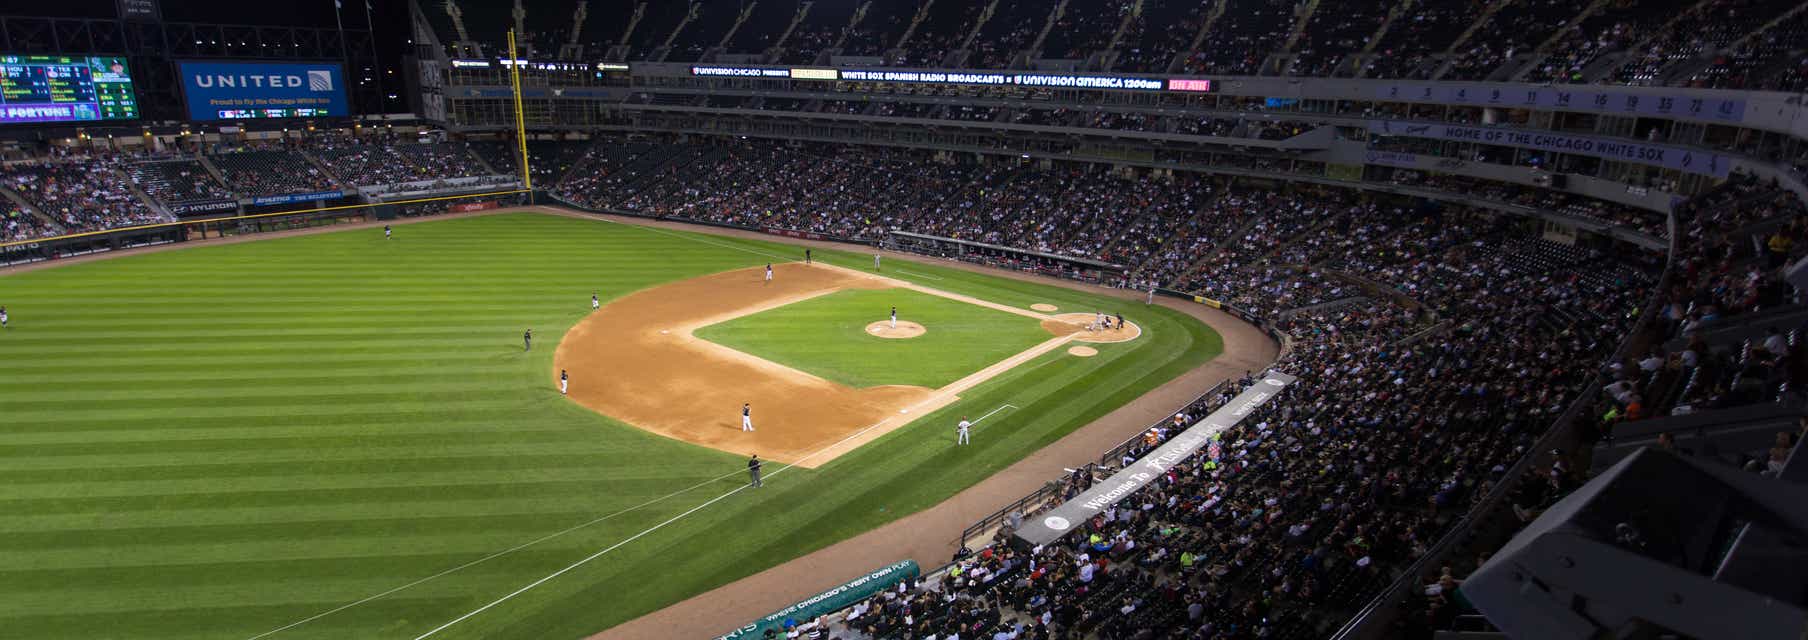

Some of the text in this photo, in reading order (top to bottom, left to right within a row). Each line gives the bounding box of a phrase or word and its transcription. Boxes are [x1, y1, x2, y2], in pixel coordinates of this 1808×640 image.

[734, 68, 760, 76] CHICAGO
[842, 71, 866, 79] WHITE
[867, 72, 884, 80] SOX
[885, 72, 919, 81] SPANISH
[920, 73, 946, 82] RADIO
[948, 74, 1004, 84] BROADCASTS
[195, 75, 302, 88] UNITED
[269, 97, 295, 105] Chicago
[1527, 91, 1537, 101] 11
[1557, 92, 1571, 103] 14
[8, 107, 71, 118] FORTUNE
[1446, 127, 1664, 161] HOME OF THE CHICAGO WHITE SOX
[190, 201, 237, 212] HYUNDAI
[6, 242, 39, 252] PATIO
[1083, 472, 1150, 509] Welcome To
[766, 560, 910, 621] WHERE CHICAGO'S VERY OWN PLAY
